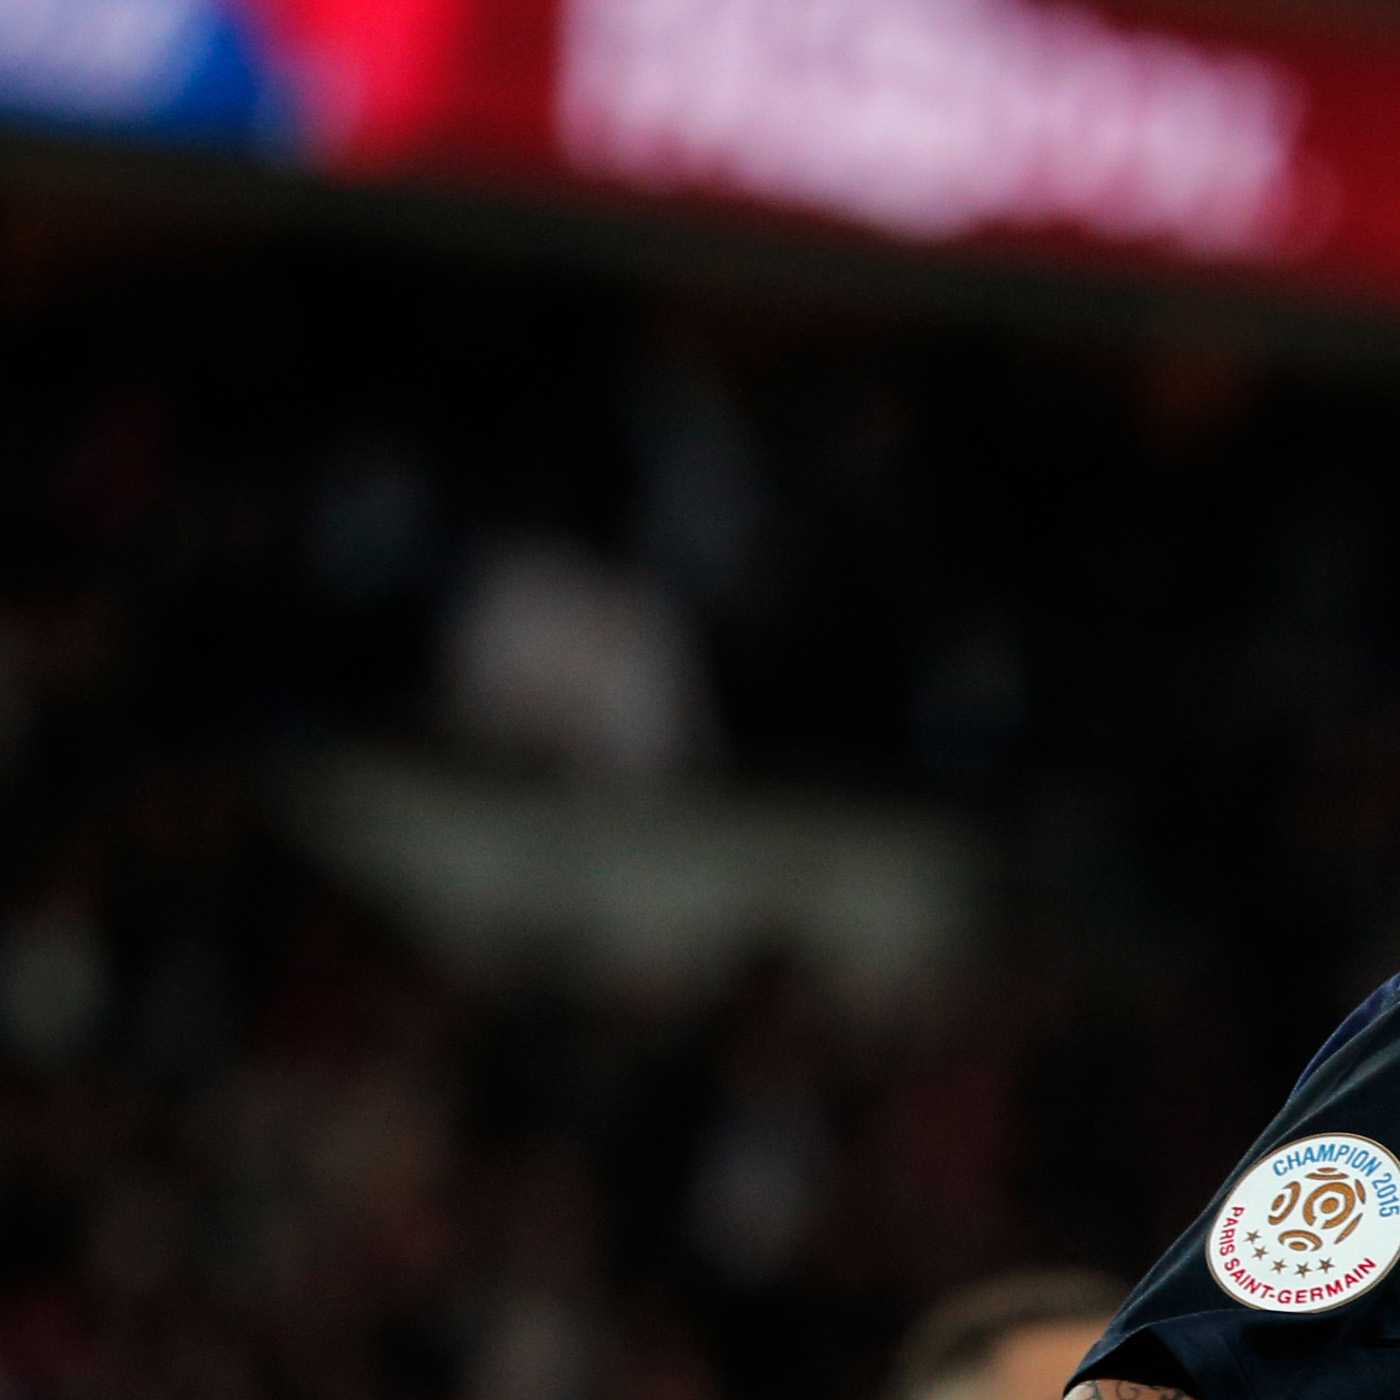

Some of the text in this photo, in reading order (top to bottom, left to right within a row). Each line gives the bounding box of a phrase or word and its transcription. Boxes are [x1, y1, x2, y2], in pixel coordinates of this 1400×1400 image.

[1272, 1143, 1400, 1218] CHAMPION 2015
[1218, 1206, 1378, 1305] PARIS SAINT-GERMAIN
